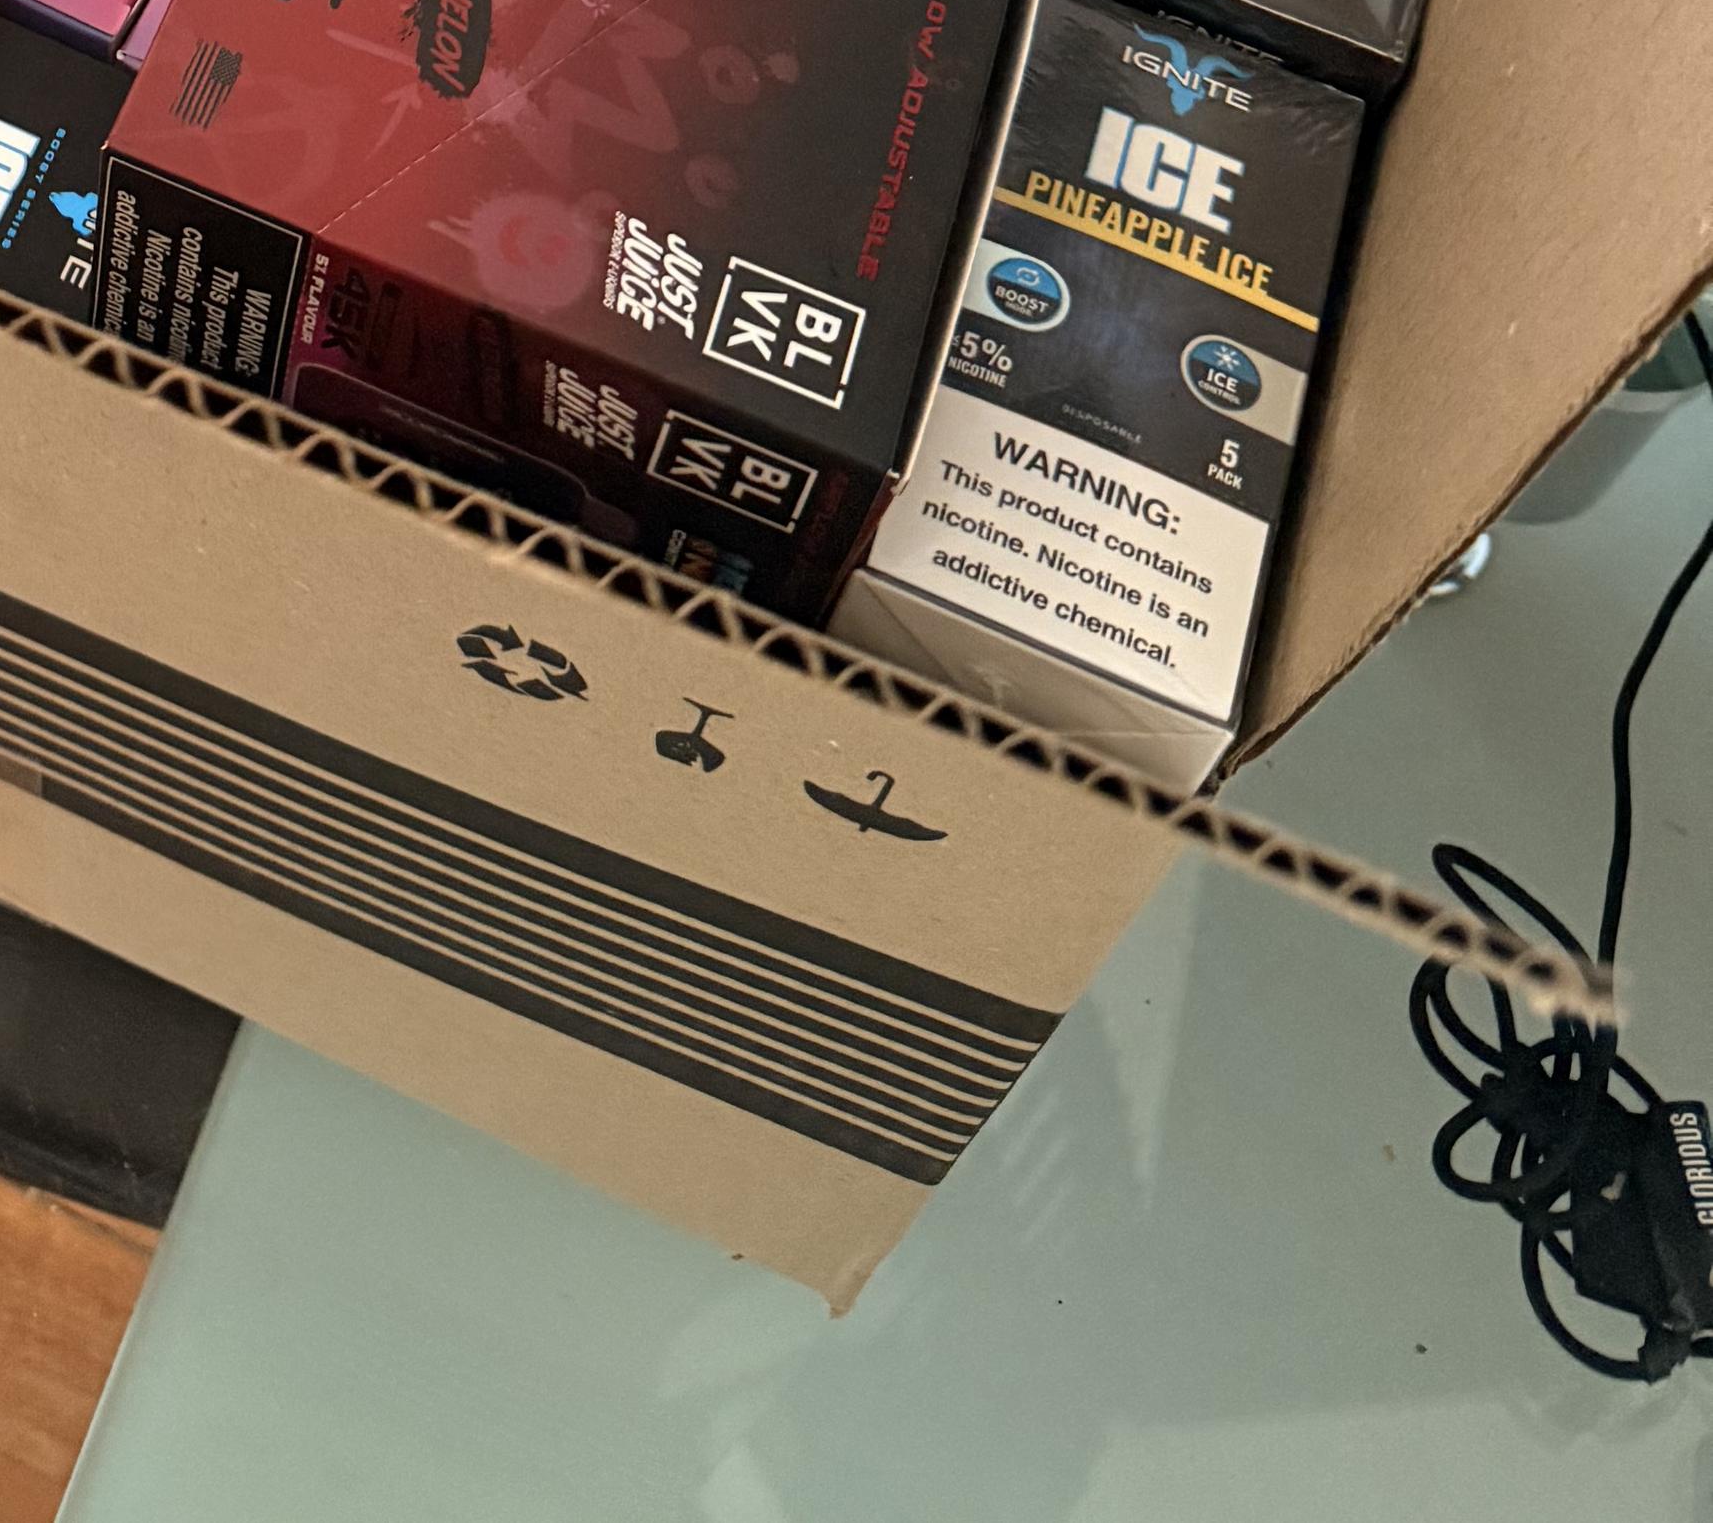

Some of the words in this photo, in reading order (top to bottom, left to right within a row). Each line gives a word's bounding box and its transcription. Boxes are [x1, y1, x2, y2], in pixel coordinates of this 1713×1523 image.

[1122, 44, 1254, 114] IGNITE
[34, 127, 67, 184] BOOST
[857, 65, 932, 283] ADJUSTABLE
[1084, 106, 1248, 234] ICE
[1, 187, 37, 249] SERIES
[1026, 170, 1212, 266] PINEAPPLE
[1216, 246, 1275, 297] ICE
[994, 285, 1050, 314] BOOST
[948, 355, 1008, 389] NICOTINE
[1207, 369, 1239, 393] ICE
[1062, 404, 1142, 445] DISPOSABLE
[1220, 438, 1240, 470] 5
[991, 430, 1183, 537] WARNING:
[1208, 463, 1244, 491] PACK
[939, 458, 995, 501] This
[997, 482, 1100, 546] product
[1104, 526, 1215, 596] contains
[921, 501, 1031, 563] nicotine.
[1036, 542, 1144, 612] Nicotine
[1148, 590, 1175, 623] is
[1177, 606, 1211, 643] an
[931, 548, 1050, 615] addictive
[1053, 598, 1179, 672] chemical.
